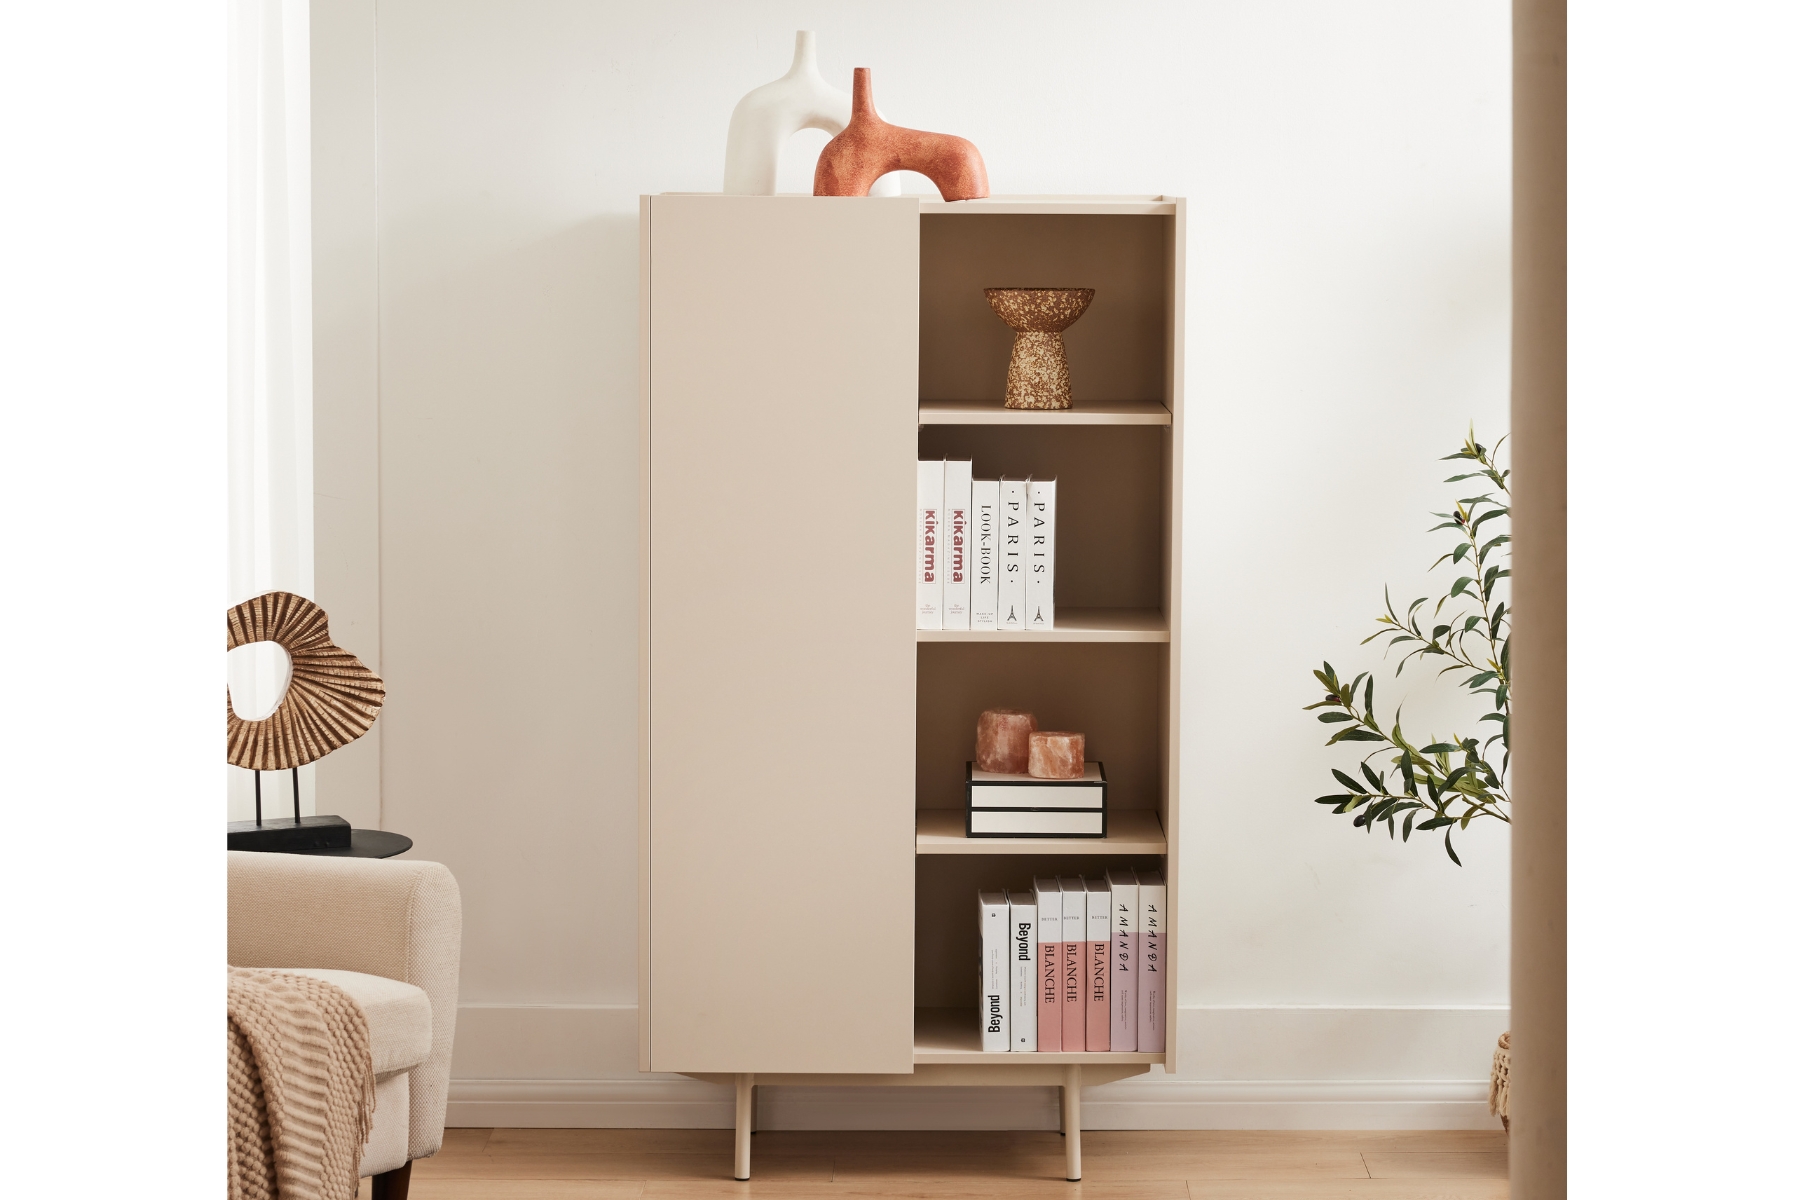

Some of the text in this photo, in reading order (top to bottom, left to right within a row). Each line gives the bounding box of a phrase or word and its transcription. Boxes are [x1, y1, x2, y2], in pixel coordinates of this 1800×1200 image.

[980, 505, 991, 584] LOOK-BOOK
[1007, 502, 1019, 573] PARIS
[1033, 502, 1045, 573] PARIS
[1016, 922, 1031, 961] Beyond
[1119, 903, 1129, 972] AMANDA
[1147, 904, 1158, 973] AMANDA
[1044, 945, 1055, 1004] BLANCHE
[1066, 944, 1077, 1003] BLANCHE
[1093, 943, 1104, 1002] BLANCHE
[988, 994, 1003, 1033] Beyond
